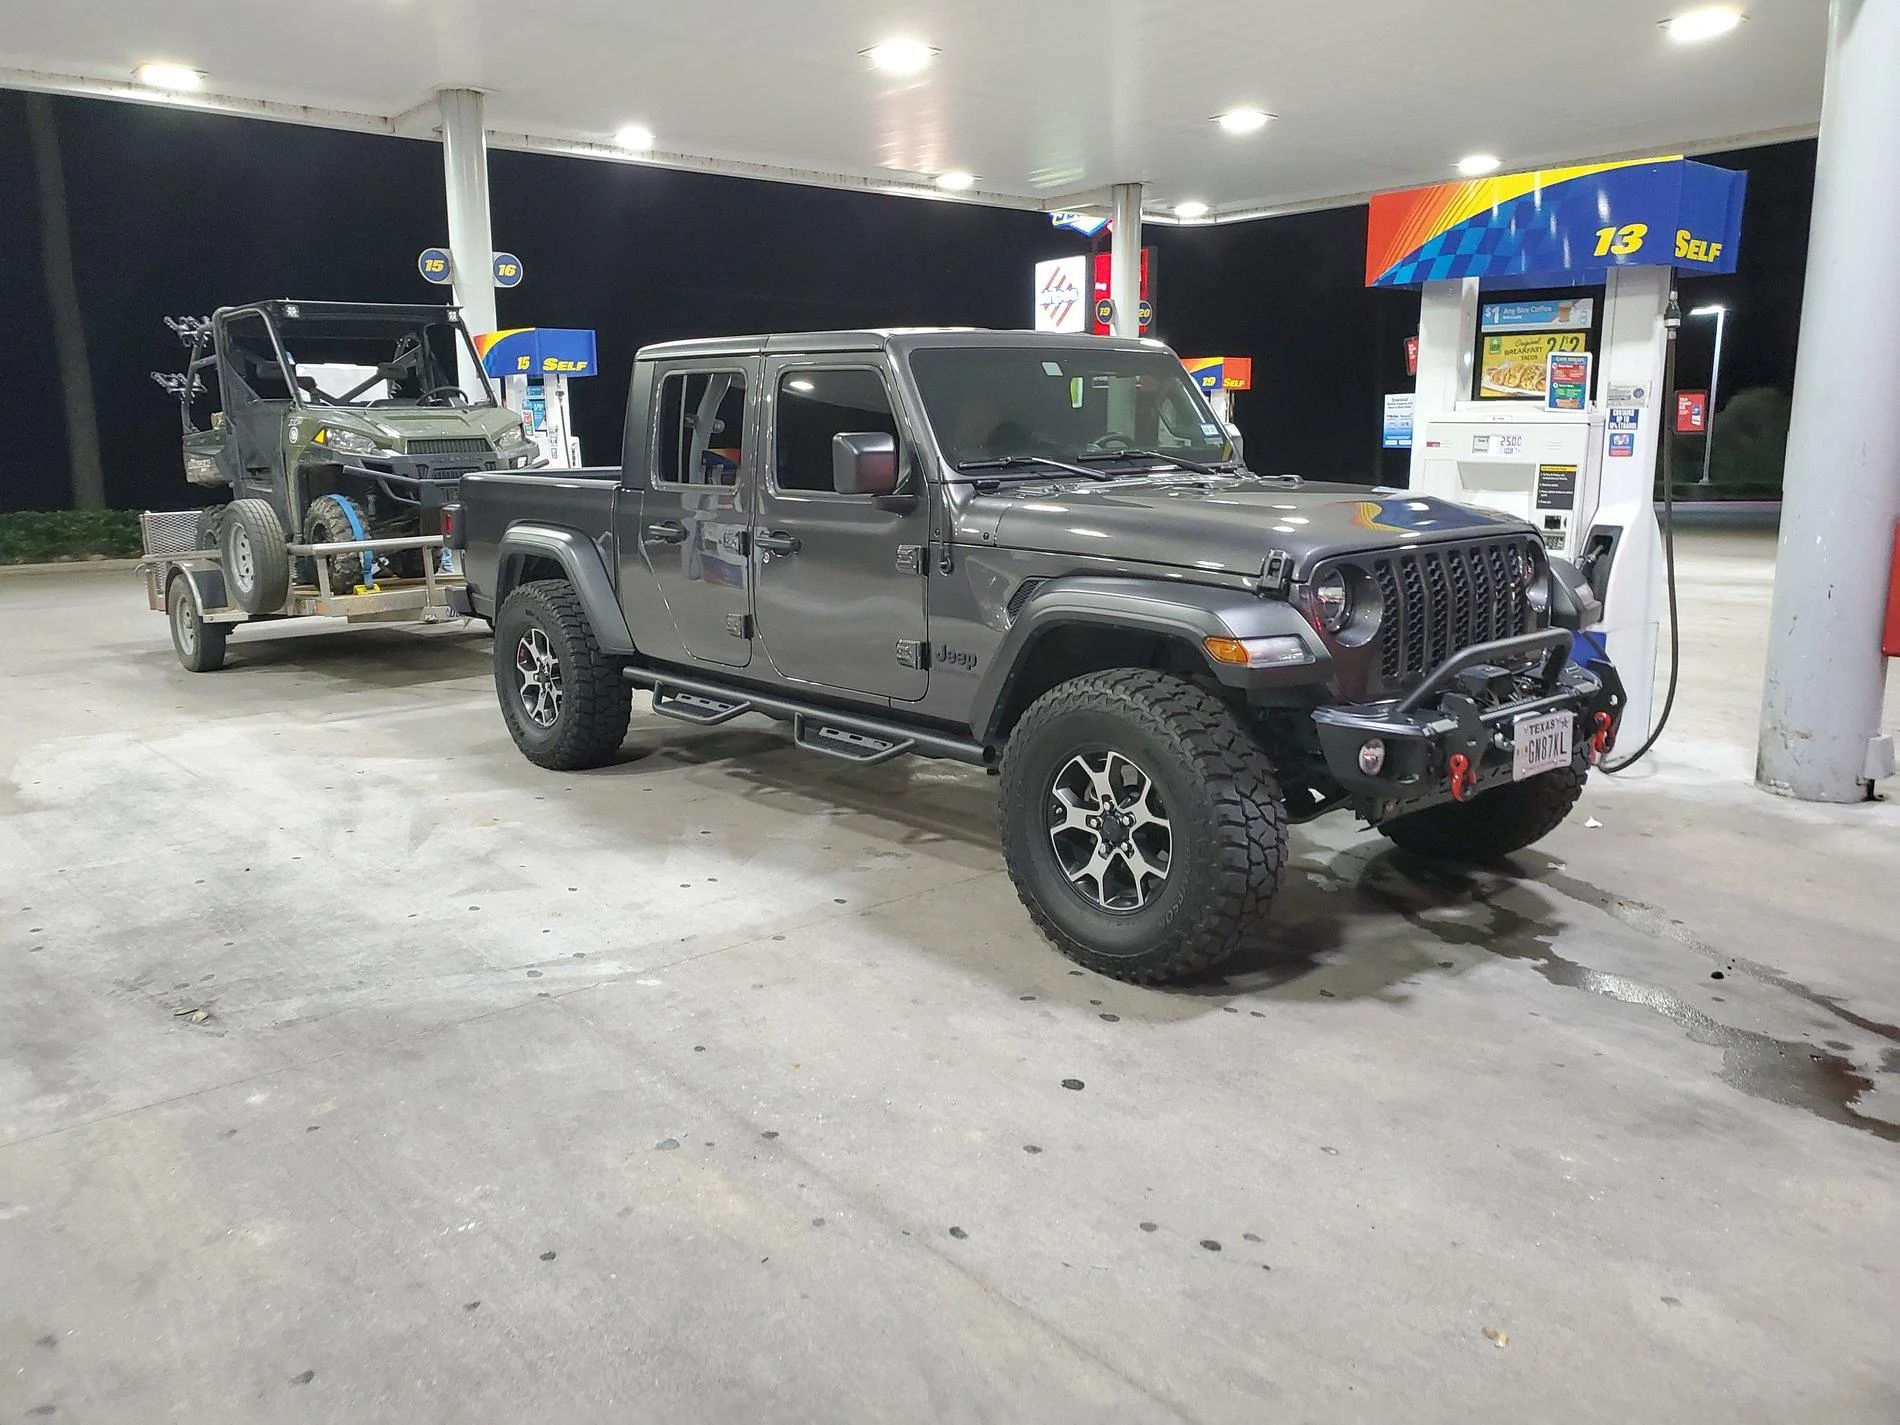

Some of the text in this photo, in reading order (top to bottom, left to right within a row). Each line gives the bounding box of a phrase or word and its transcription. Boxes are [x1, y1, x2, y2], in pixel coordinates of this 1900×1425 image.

[1593, 223, 1648, 256] 13
[1674, 229, 1723, 263] SELF
[425, 259, 445, 273] 15
[498, 264, 517, 277] 16
[1099, 309, 1111, 317] 19
[1504, 346, 1543, 356] BREAKFAST
[517, 355, 531, 370] 15
[542, 357, 588, 371] SELF
[1202, 376, 1217, 387] 19
[1222, 377, 1246, 388] SELF
[936, 644, 978, 671] Jeep
[1529, 720, 1555, 735] TEXAS
